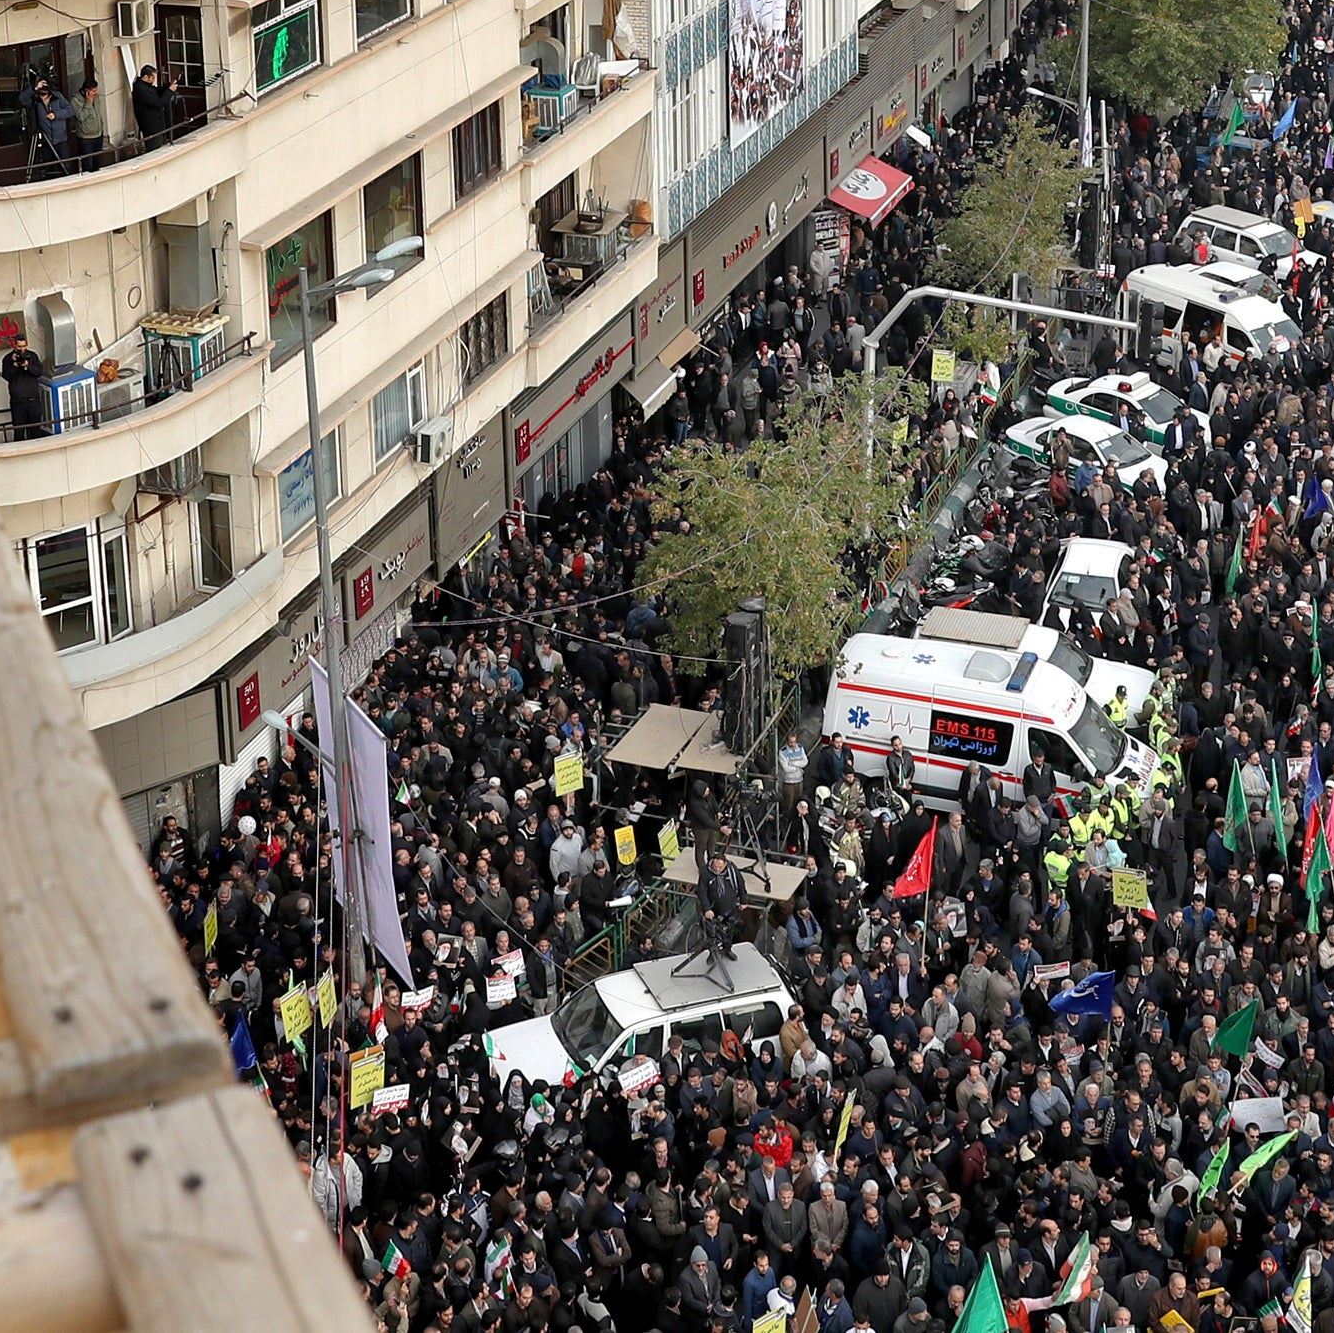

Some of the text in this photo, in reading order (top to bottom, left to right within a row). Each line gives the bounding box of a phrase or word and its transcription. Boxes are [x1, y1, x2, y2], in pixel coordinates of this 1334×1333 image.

[244, 681, 255, 697] 50
[936, 719, 996, 739] EMS 115
[934, 735, 996, 756] اورژانس تهران
